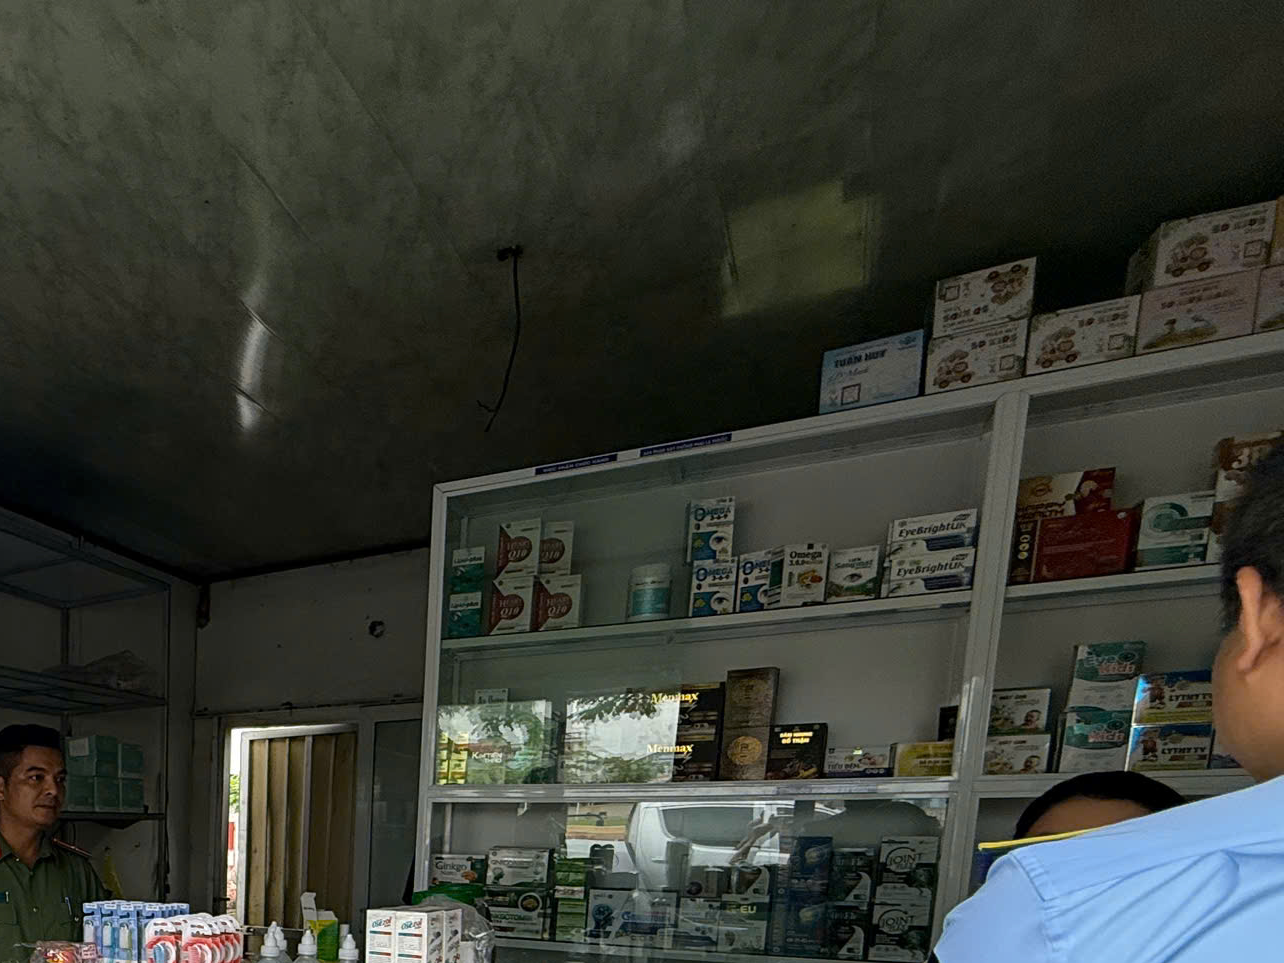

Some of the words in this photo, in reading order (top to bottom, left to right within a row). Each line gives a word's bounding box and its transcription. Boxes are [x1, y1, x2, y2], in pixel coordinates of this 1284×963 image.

[694, 507, 731, 521] OMEGA
[789, 551, 822, 561] Omega
[696, 567, 733, 581] OMEGA
[436, 860, 468, 872] Ginkgo
